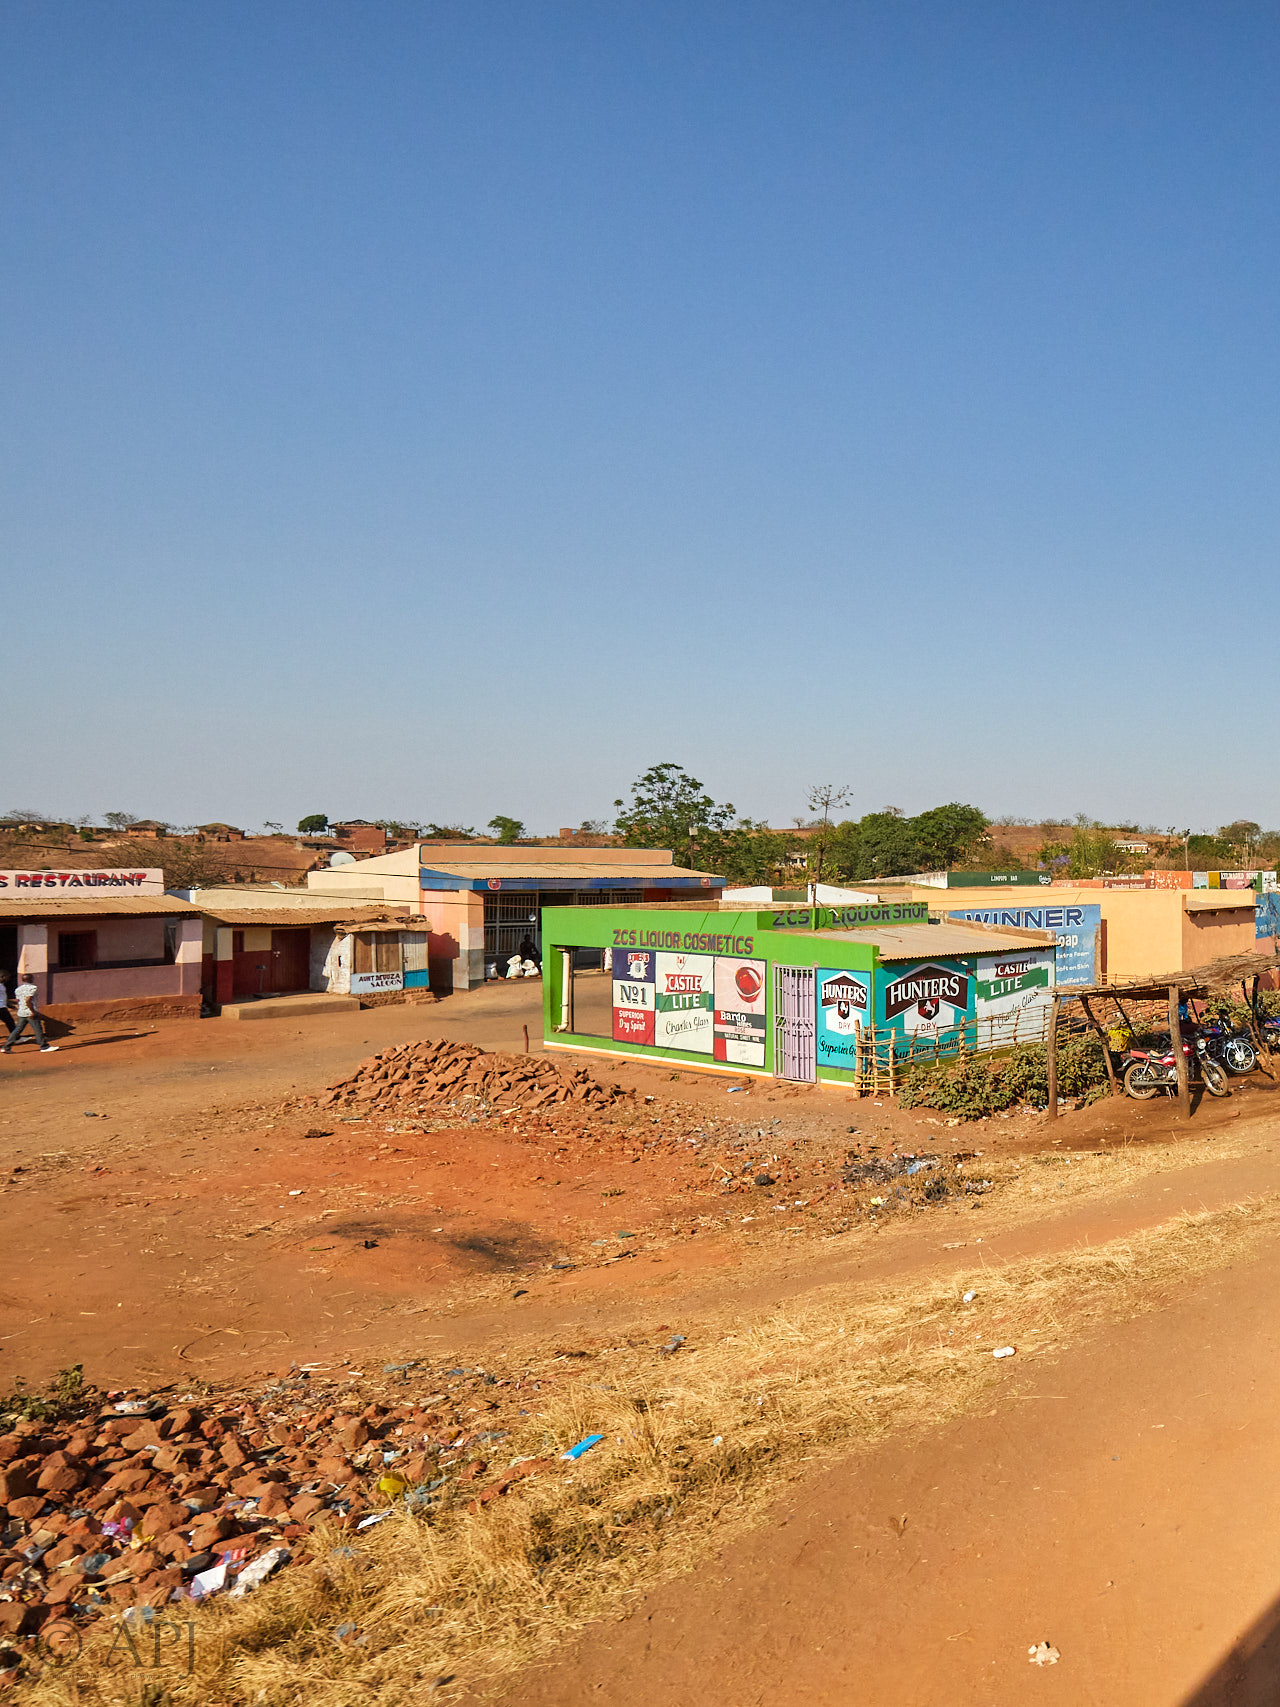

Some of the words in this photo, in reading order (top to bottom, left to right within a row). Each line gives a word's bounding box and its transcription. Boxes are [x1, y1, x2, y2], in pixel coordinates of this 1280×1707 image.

[15, 872, 147, 888] RESTAURANT
[772, 909, 810, 928] ZCS
[892, 902, 928, 920] SHOP
[965, 907, 1084, 929] WINNER
[612, 929, 637, 946] ZCS
[640, 929, 681, 949] LIQUOR
[684, 932, 754, 955] COSMETICS
[1056, 934, 1078, 948] oap
[997, 962, 1028, 976] CASTLE
[371, 979, 402, 987] SALOON
[668, 975, 702, 992] CASTLE
[890, 976, 959, 1006] HUNTERS
[990, 976, 1022, 997] LITE
[672, 993, 700, 1009] LITE
[821, 984, 867, 1004] HUNTERS
[618, 1009, 645, 1020] SUPERIOR
[720, 1010, 747, 1022] Bardo
[838, 1022, 851, 1030] DRY
[920, 1021, 937, 1032] DRY
